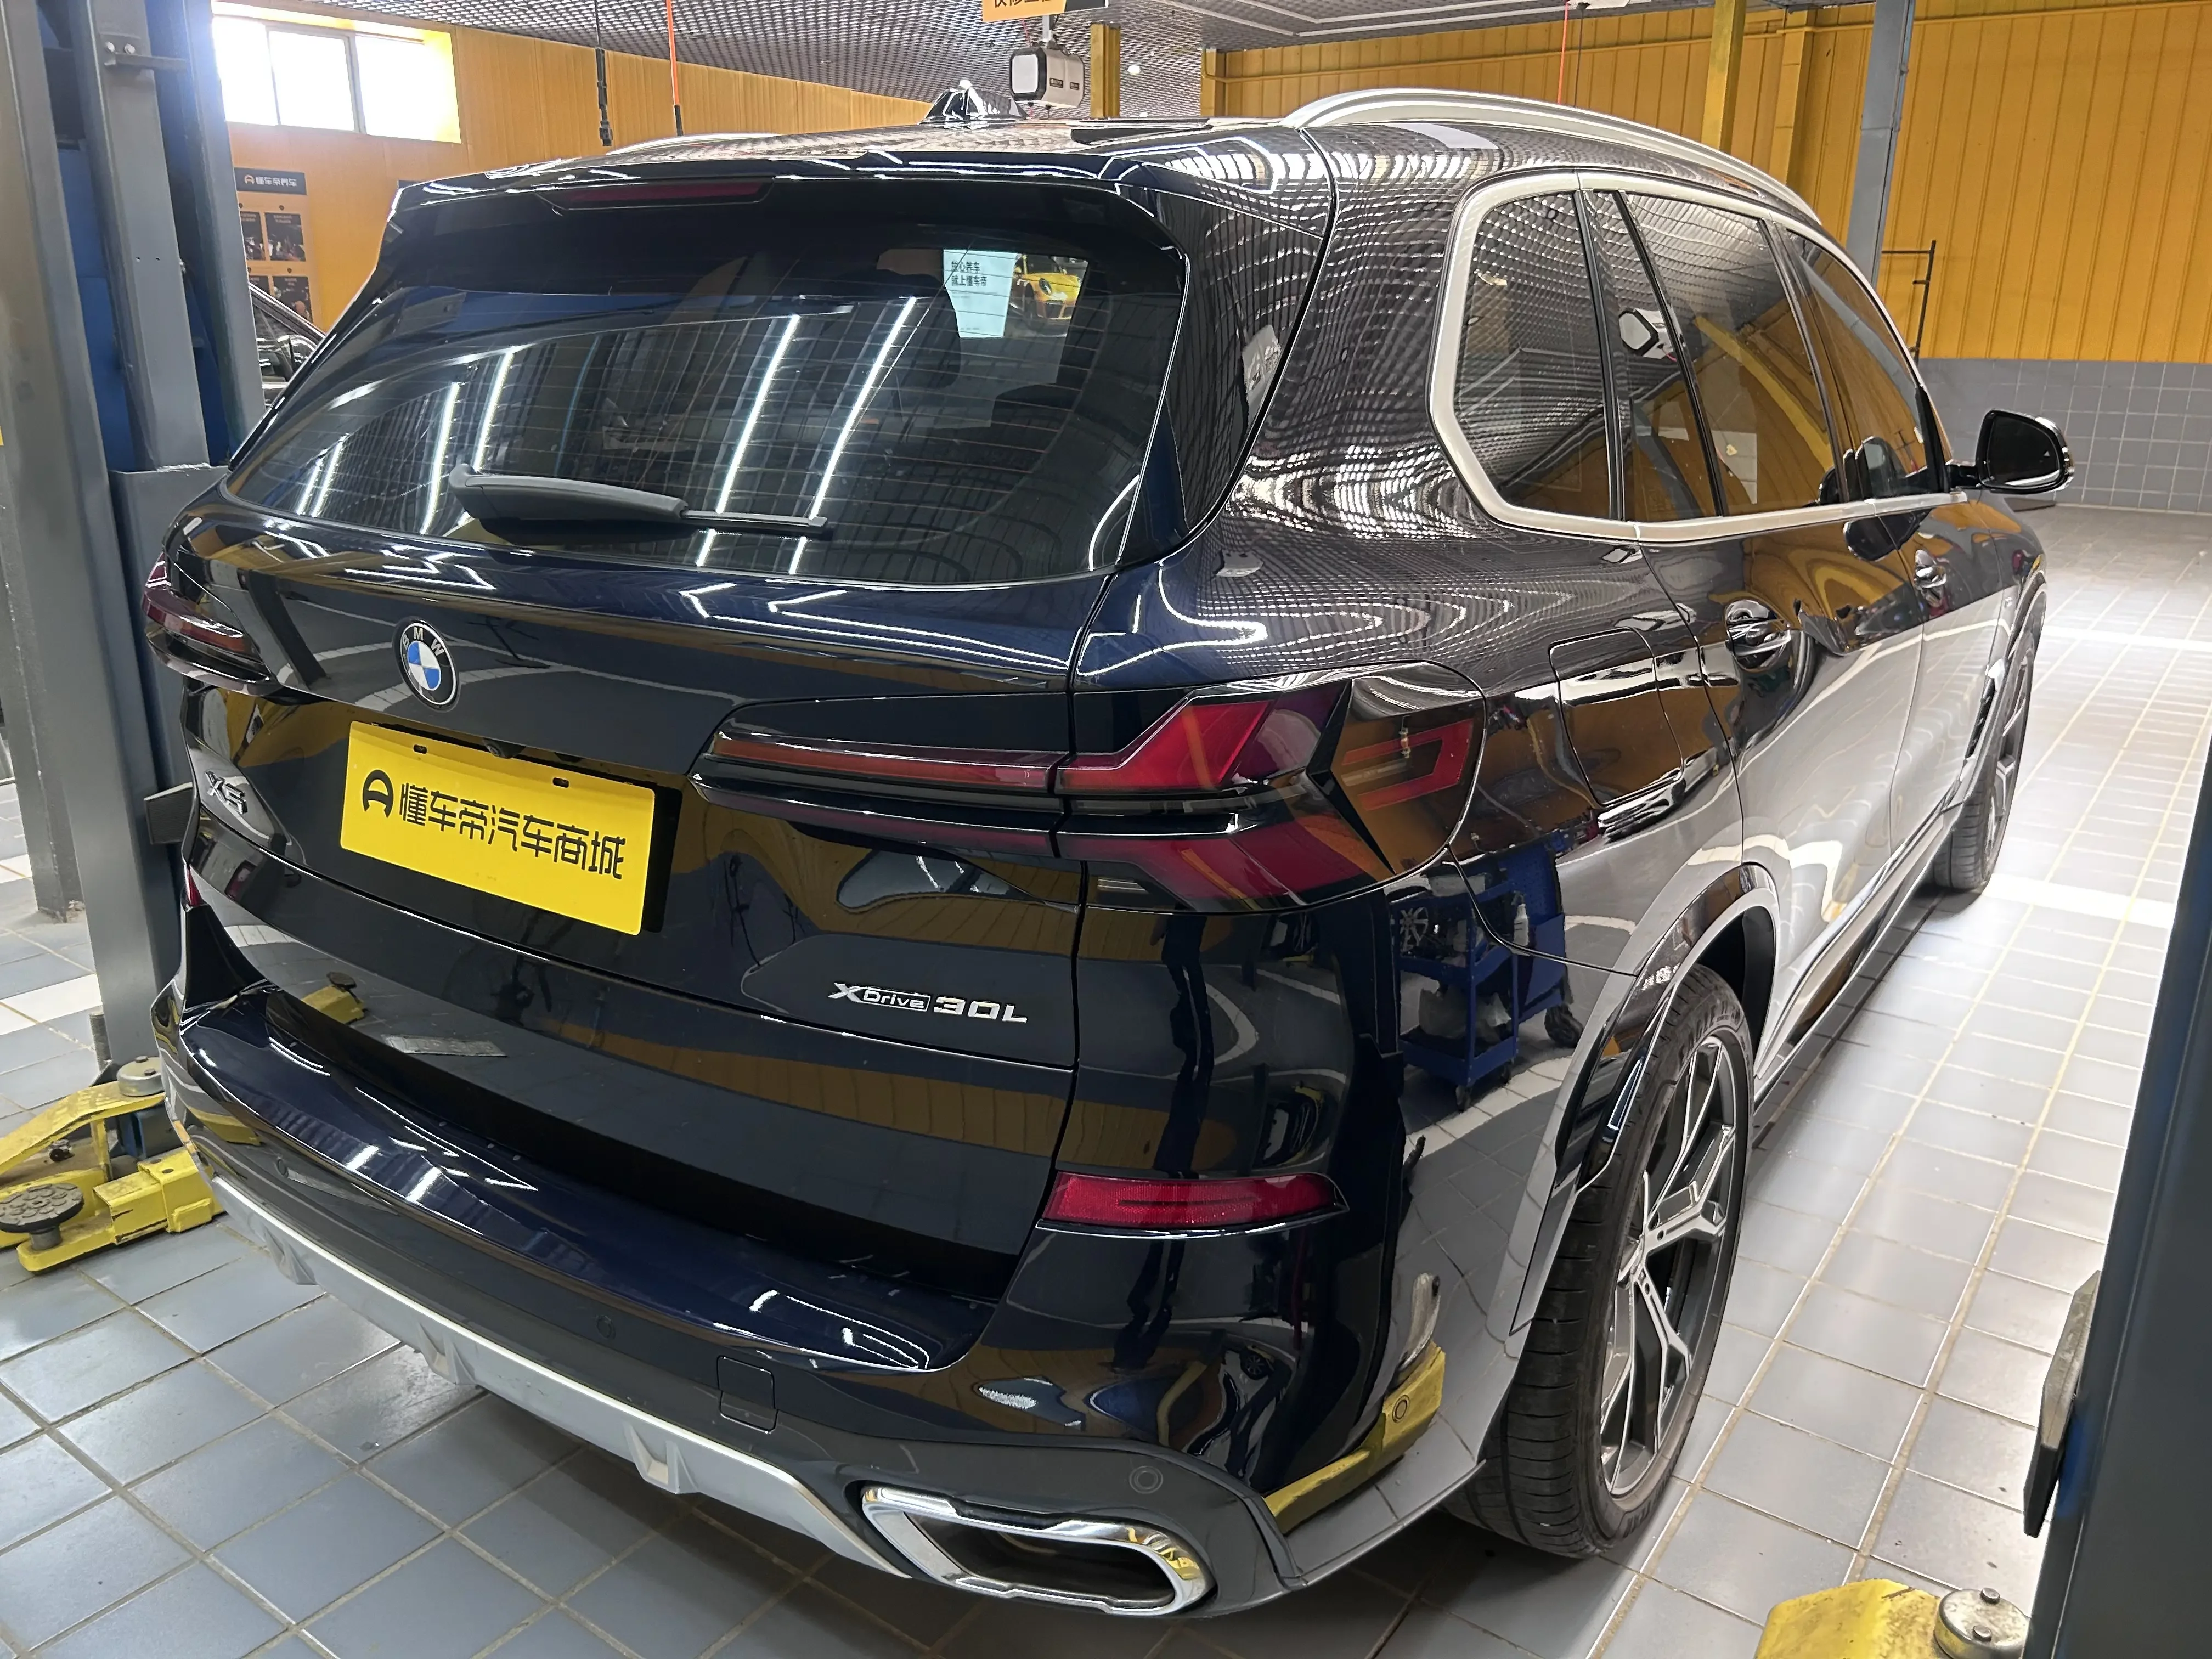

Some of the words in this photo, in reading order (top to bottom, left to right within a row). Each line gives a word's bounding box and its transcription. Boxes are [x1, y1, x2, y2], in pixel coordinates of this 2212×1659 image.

[402, 627, 445, 656] BMW
[205, 771, 247, 815] X5
[399, 782, 627, 881] 懂车帝汽车商城
[933, 996, 1028, 1024] 30L
